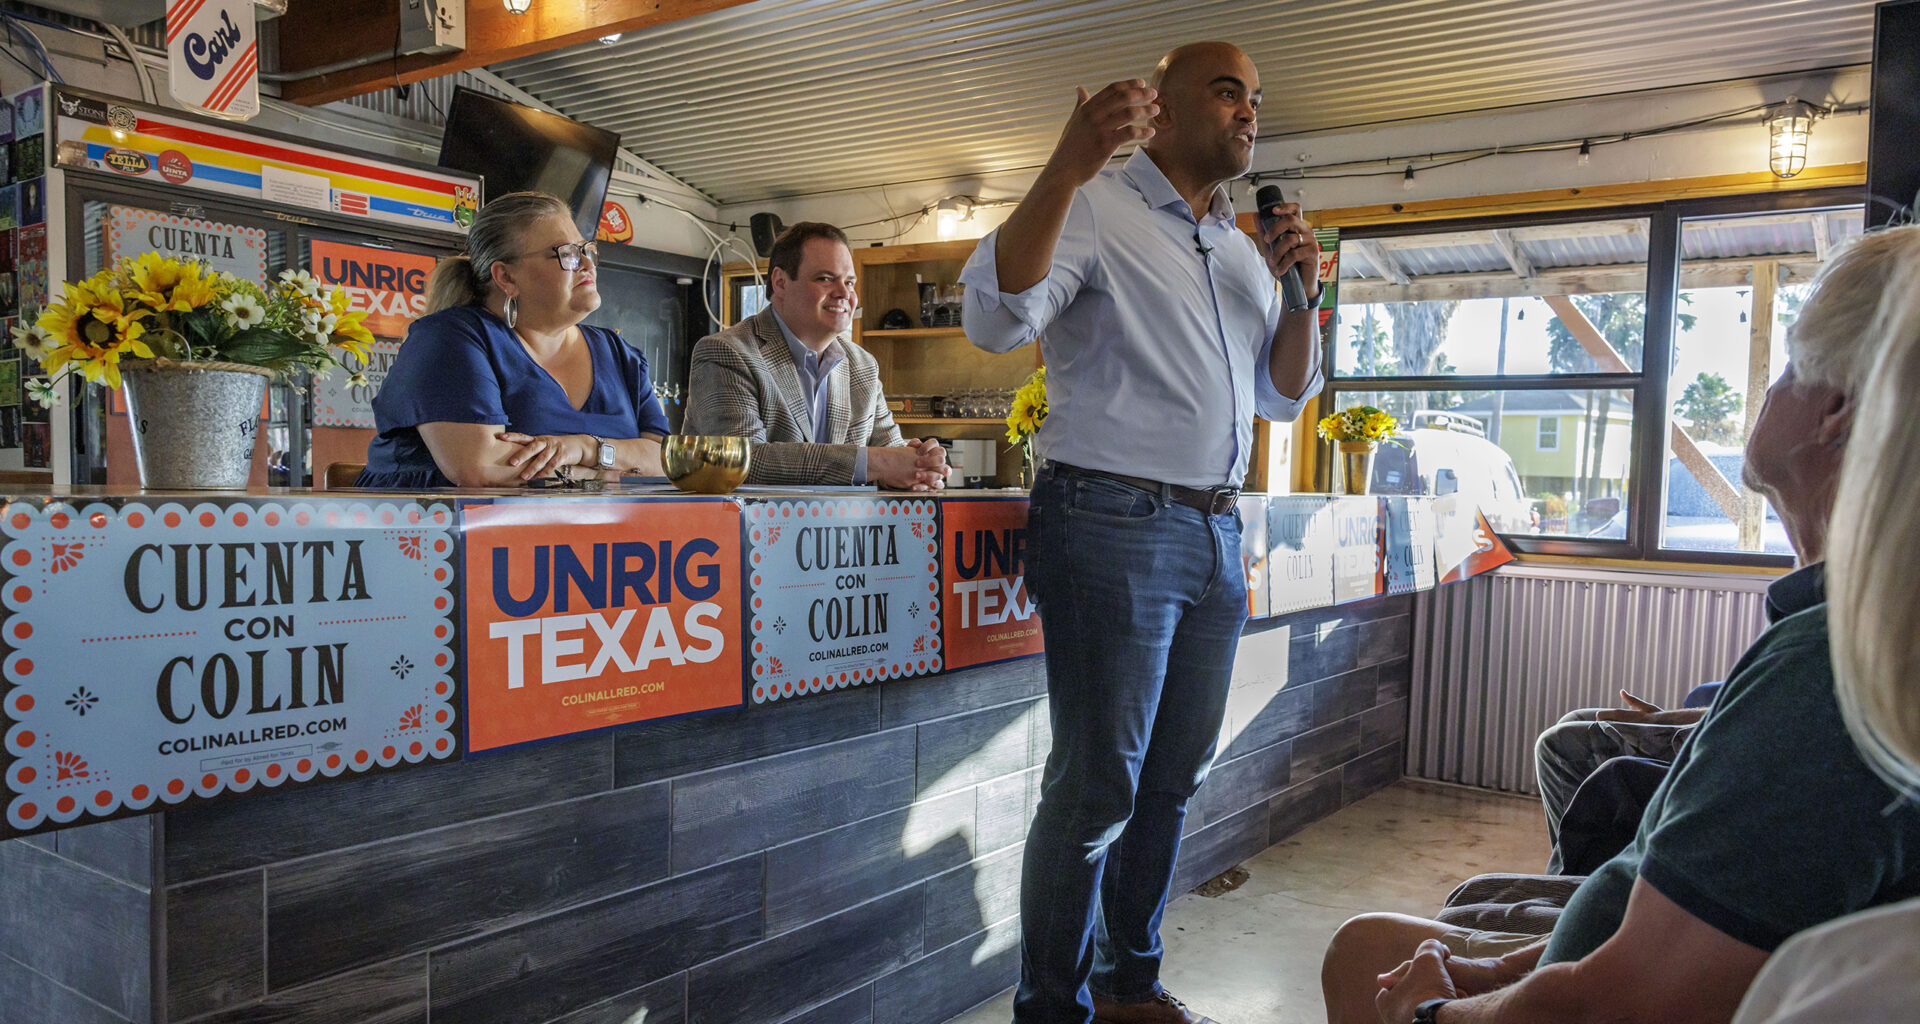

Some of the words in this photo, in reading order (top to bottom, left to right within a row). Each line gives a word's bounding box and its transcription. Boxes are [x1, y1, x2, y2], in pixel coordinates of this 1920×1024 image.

[184, 9, 241, 80] Carl
[79, 104, 106, 118] STONE
[106, 152, 147, 169] YELLA
[162, 165, 188, 177] UINTA
[148, 225, 236, 259] CUENTA
[323, 256, 426, 295] UNRIG
[796, 525, 900, 572] CUENTA
[955, 528, 1026, 579] UNR
[124, 540, 373, 614] CUENTA
[492, 538, 720, 617] UNRIG
[836, 573, 865, 590] CON
[808, 593, 889, 643] COLIN
[953, 576, 1037, 629] TEXA
[224, 615, 294, 641] CON
[489, 602, 724, 689] TEXAS
[987, 628, 1038, 643] COLINALLRED.COM
[809, 642, 889, 662] COLINALLRED.COM
[156, 642, 350, 725] COLIN
[562, 681, 665, 707] COLINALLRED.COM
[158, 716, 348, 757] COLINALLRED.COM
